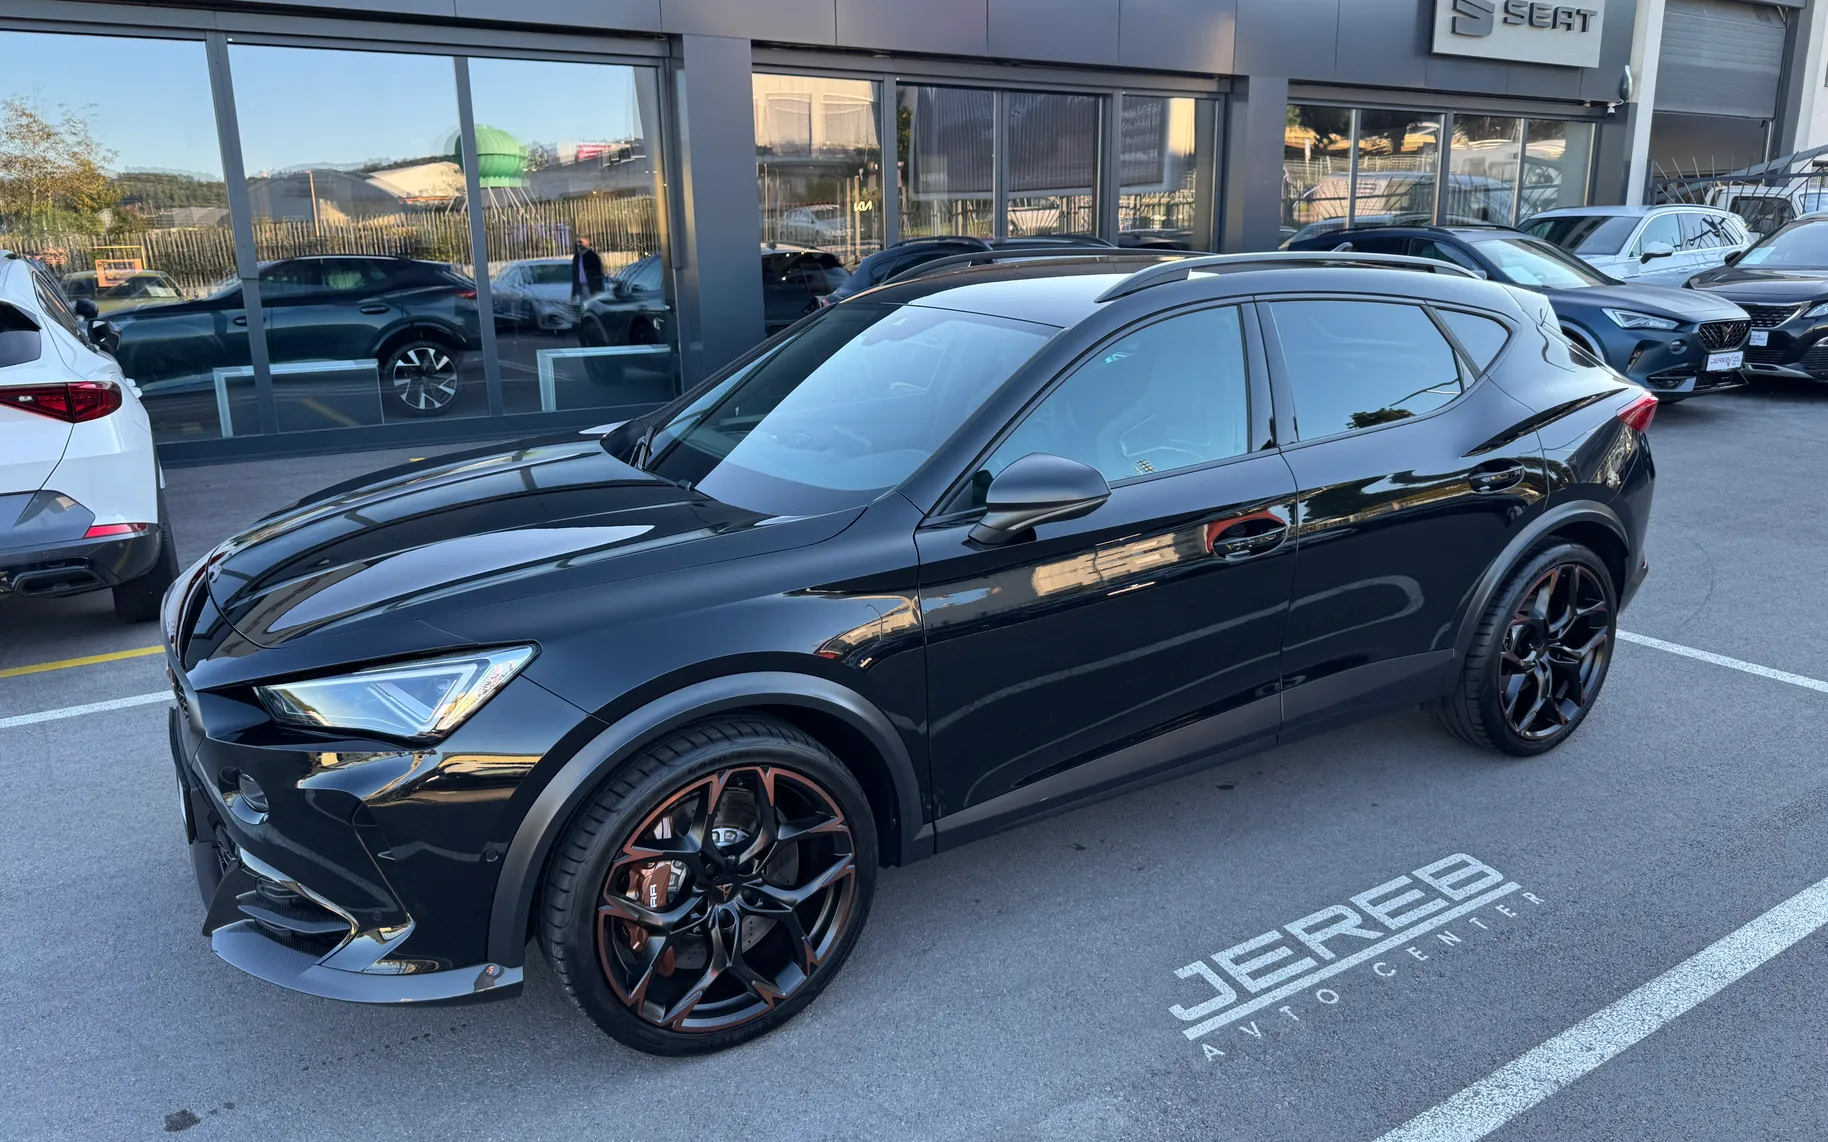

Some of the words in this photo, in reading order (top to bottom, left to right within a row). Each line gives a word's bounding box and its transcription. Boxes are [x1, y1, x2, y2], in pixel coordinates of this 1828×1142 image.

[1502, 0, 1597, 33] SEAT
[1169, 852, 1504, 1022] JEREB
[1201, 988, 1340, 1062] AVTO
[1372, 891, 1546, 978] CENTER
